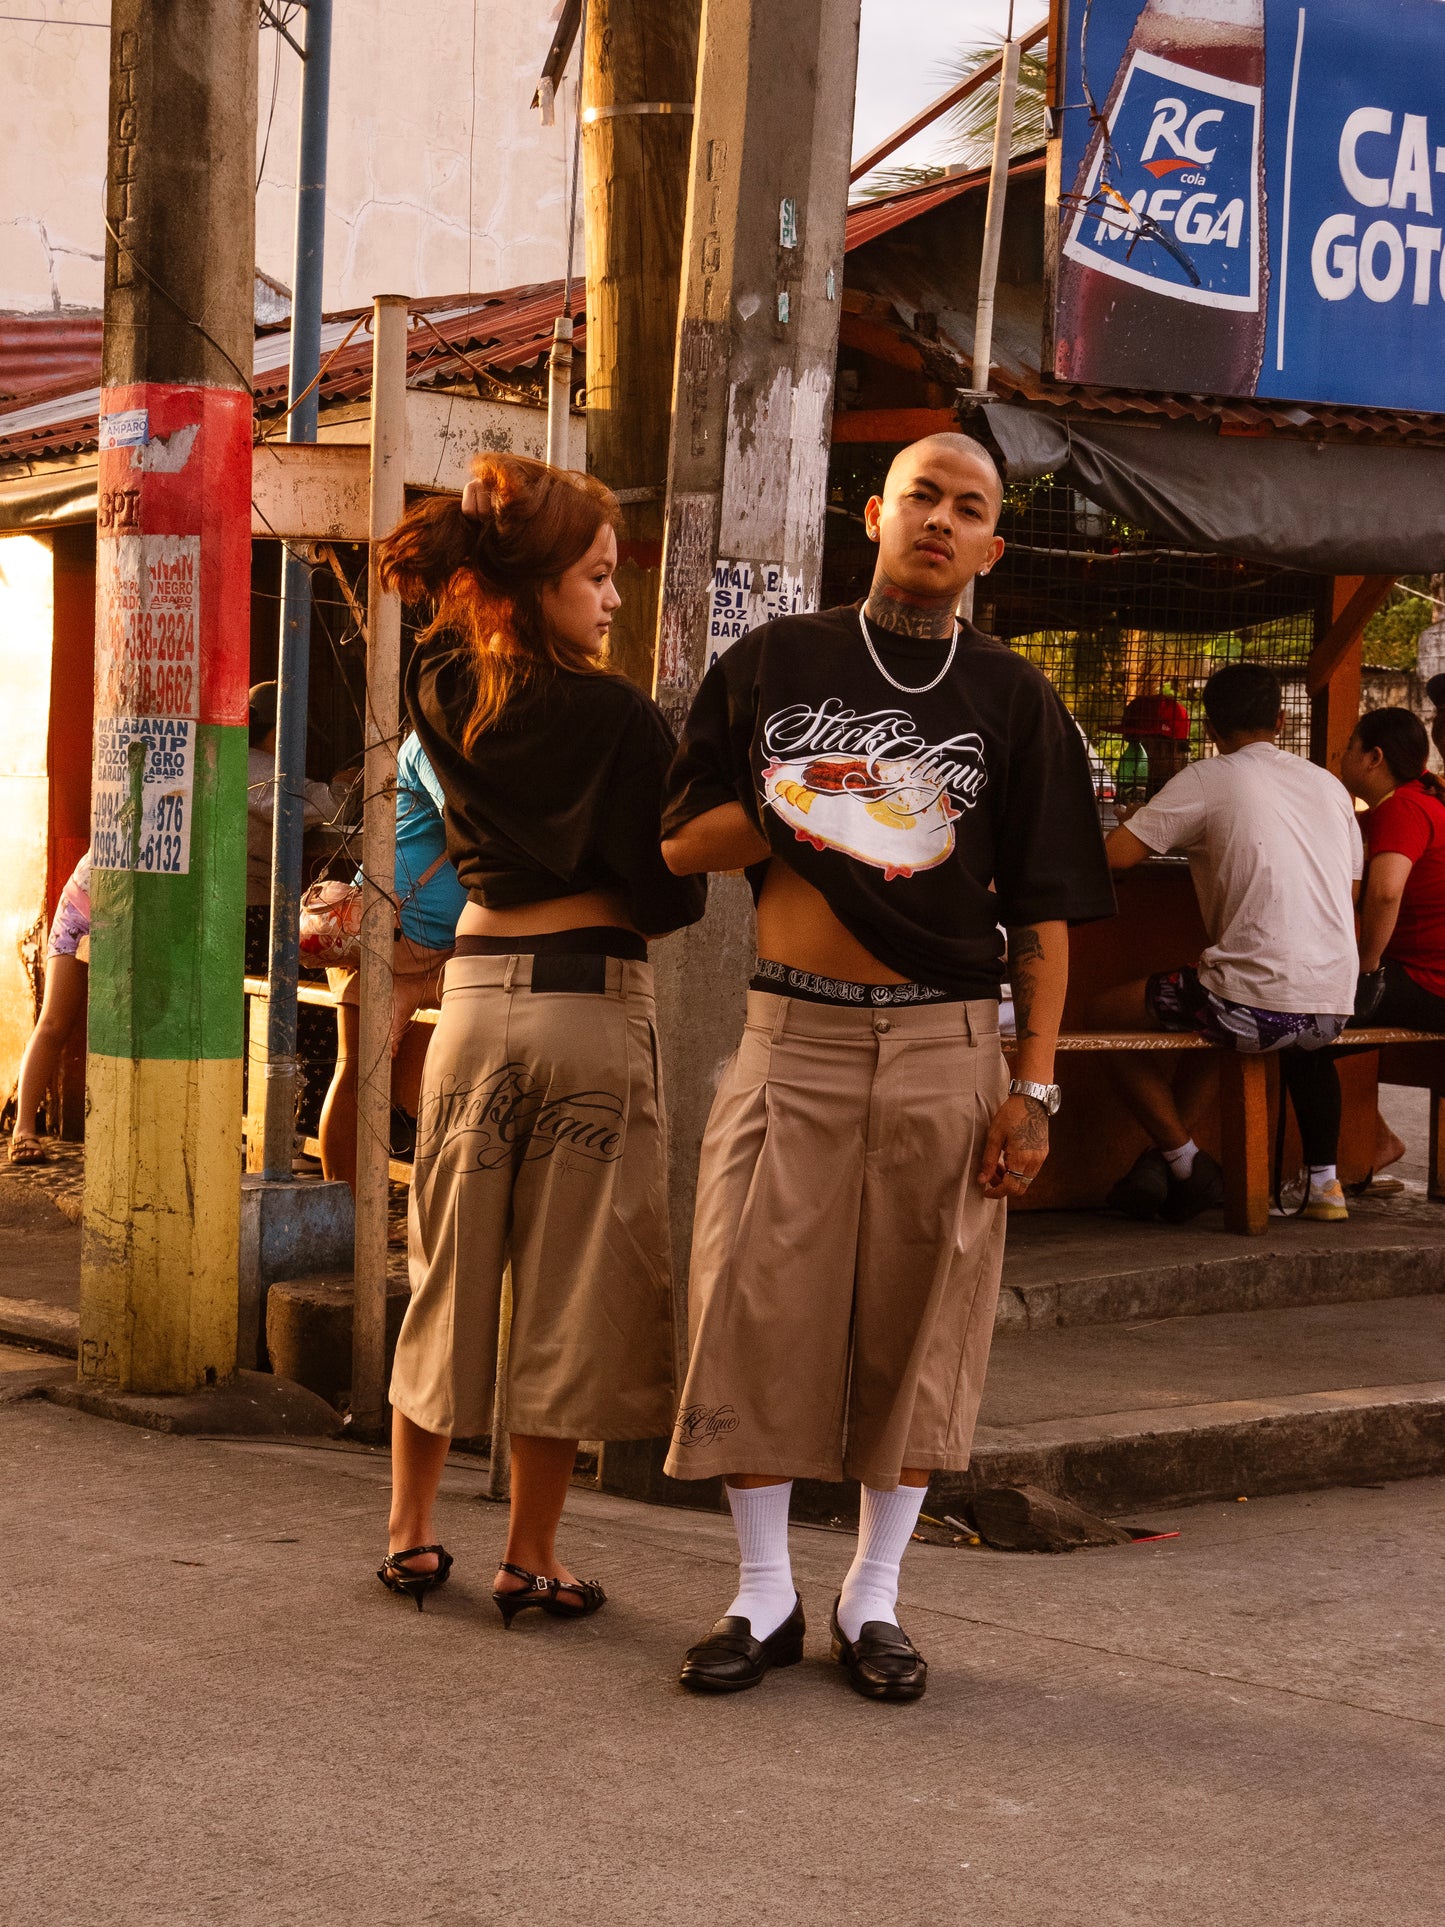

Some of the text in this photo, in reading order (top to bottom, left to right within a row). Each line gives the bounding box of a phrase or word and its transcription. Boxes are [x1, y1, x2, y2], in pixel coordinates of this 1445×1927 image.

[1140, 98, 1224, 165] RC
[1180, 171, 1206, 187] cola
[1094, 189, 1245, 249] MEGA
[1311, 213, 1445, 305] GOT
[107, 421, 147, 435] AMPARO
[156, 581, 194, 595] NEGRO
[151, 595, 193, 605] ABABO
[98, 718, 189, 737] MALABANAN
[98, 749, 186, 768] POZO GRO
[145, 767, 185, 777] ABABO
[788, 969, 866, 1003] CLIQUE
